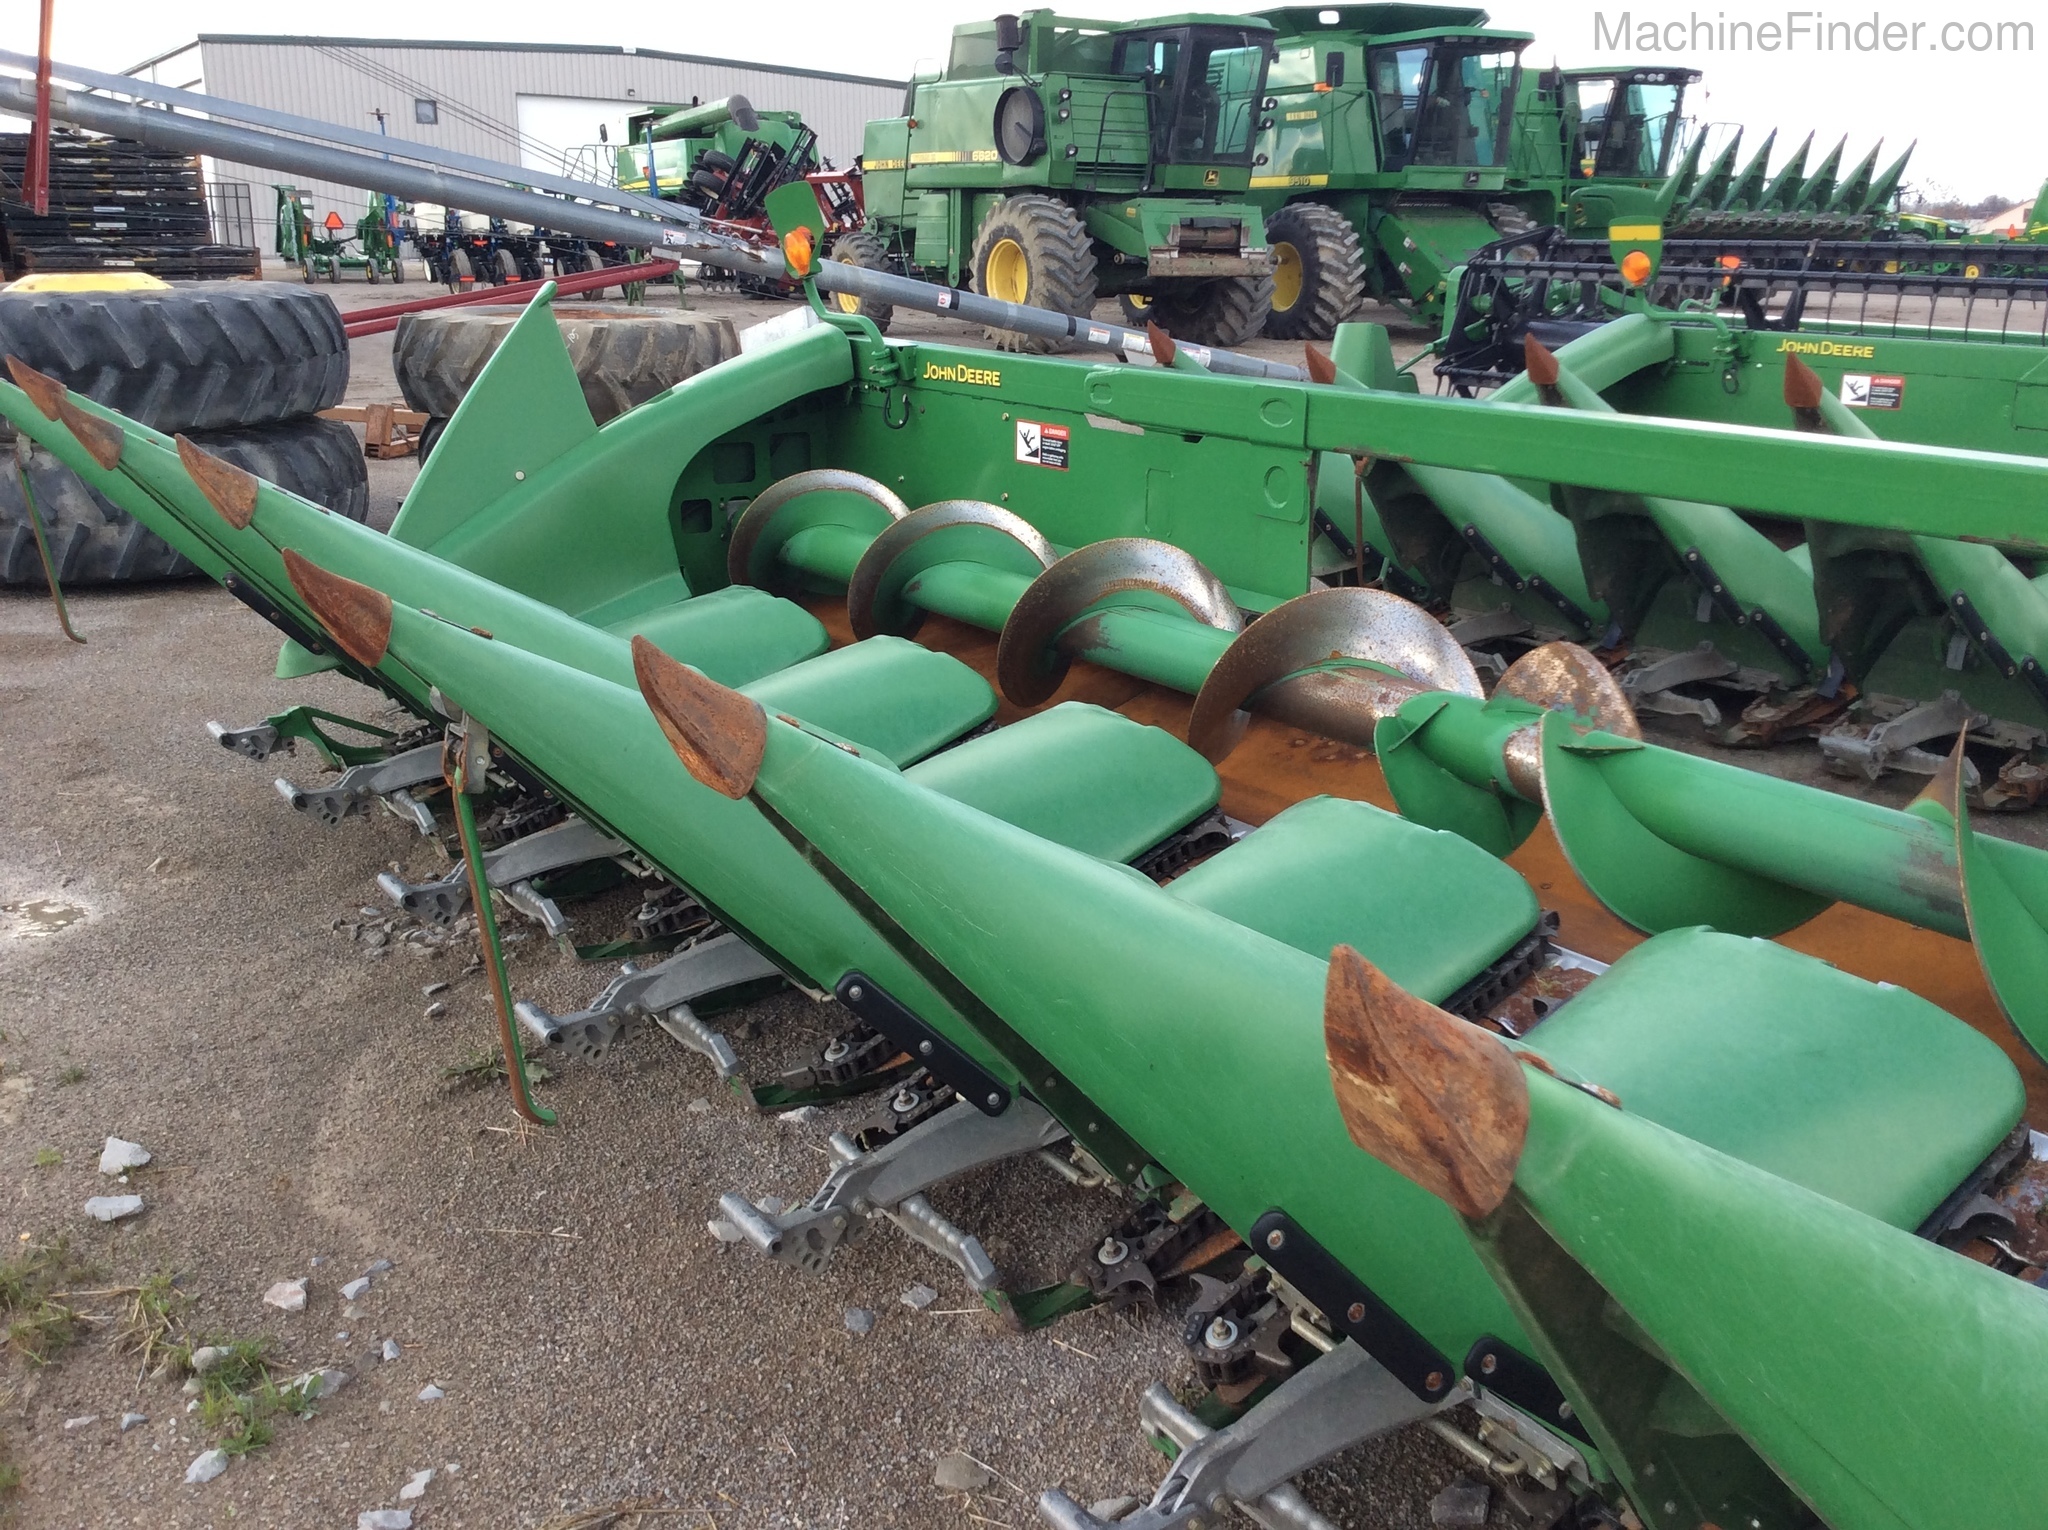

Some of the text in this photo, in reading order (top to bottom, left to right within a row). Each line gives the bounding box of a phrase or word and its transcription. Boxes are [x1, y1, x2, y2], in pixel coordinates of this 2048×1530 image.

[972, 149, 998, 162] 6620
[1776, 338, 1875, 359] JOHN DEERE
[923, 361, 1001, 387] JOHN DEERE
